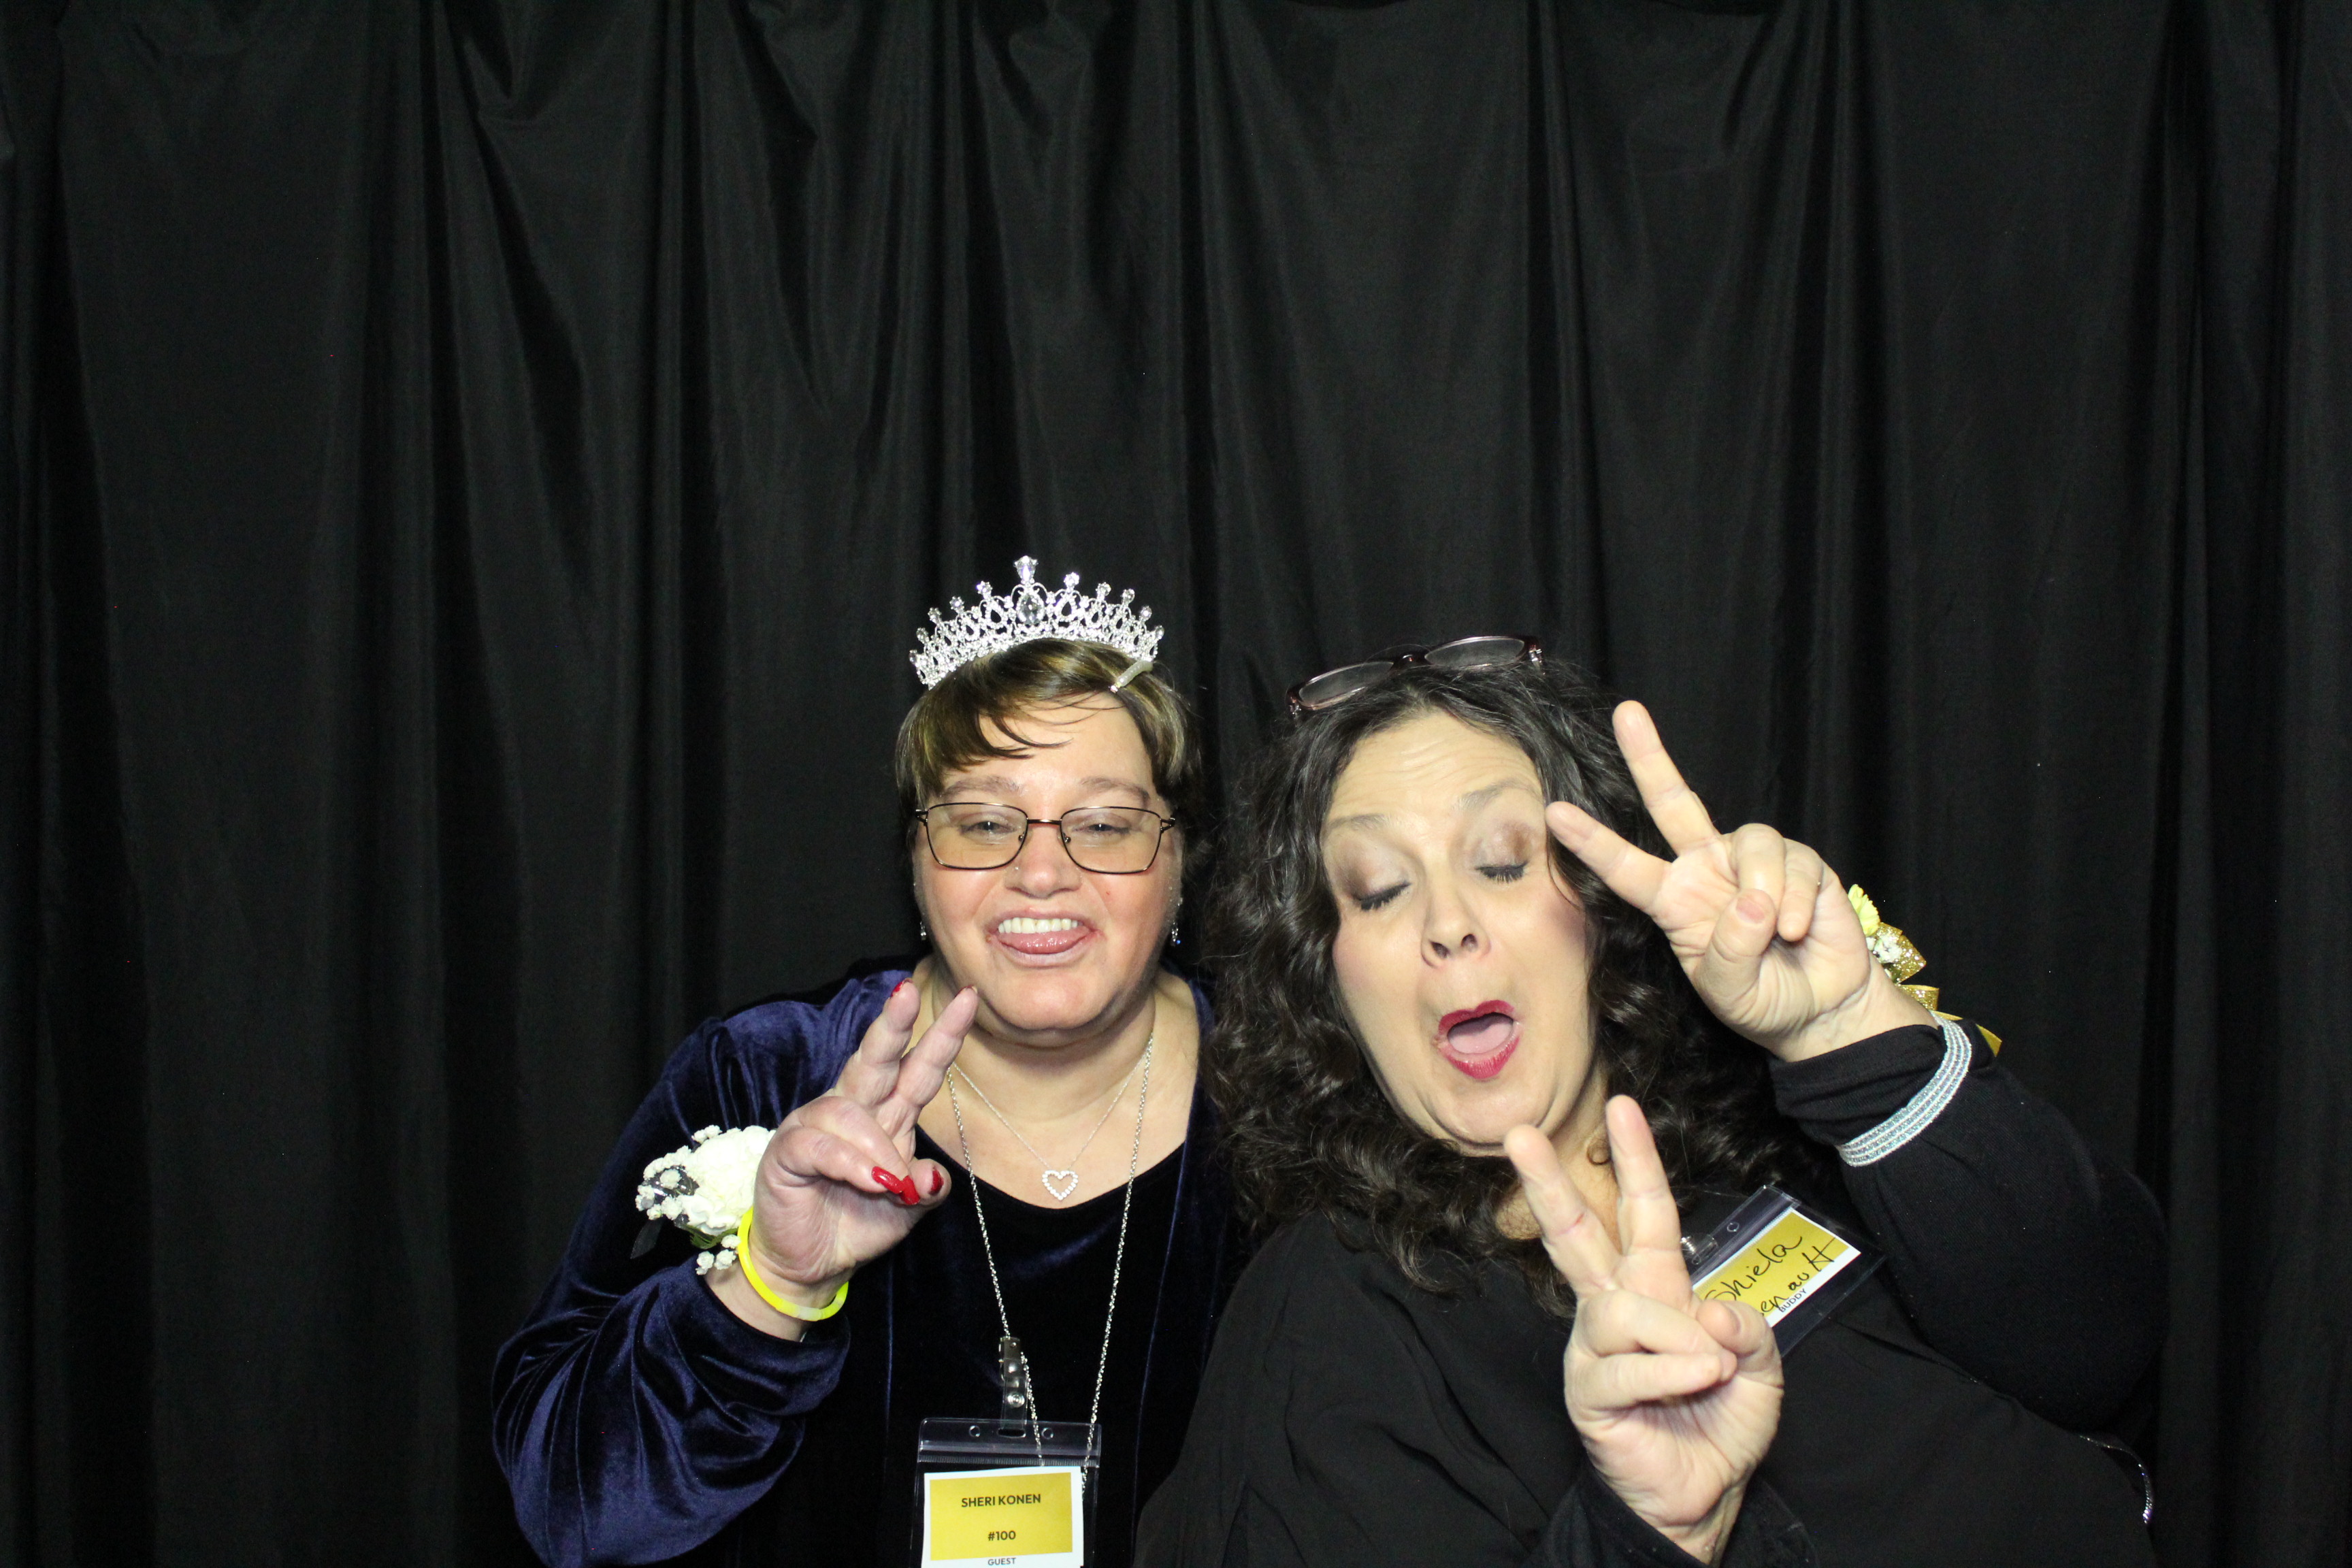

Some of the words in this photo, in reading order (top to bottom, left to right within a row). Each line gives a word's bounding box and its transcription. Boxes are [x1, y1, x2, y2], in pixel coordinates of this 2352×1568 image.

[1778, 1288, 1808, 1313] BUDDY
[961, 1496, 996, 1507] SHERI
[998, 1494, 1041, 1505] KONEN
[987, 1530, 1016, 1541] #100
[987, 1557, 1017, 1566] GUEST
